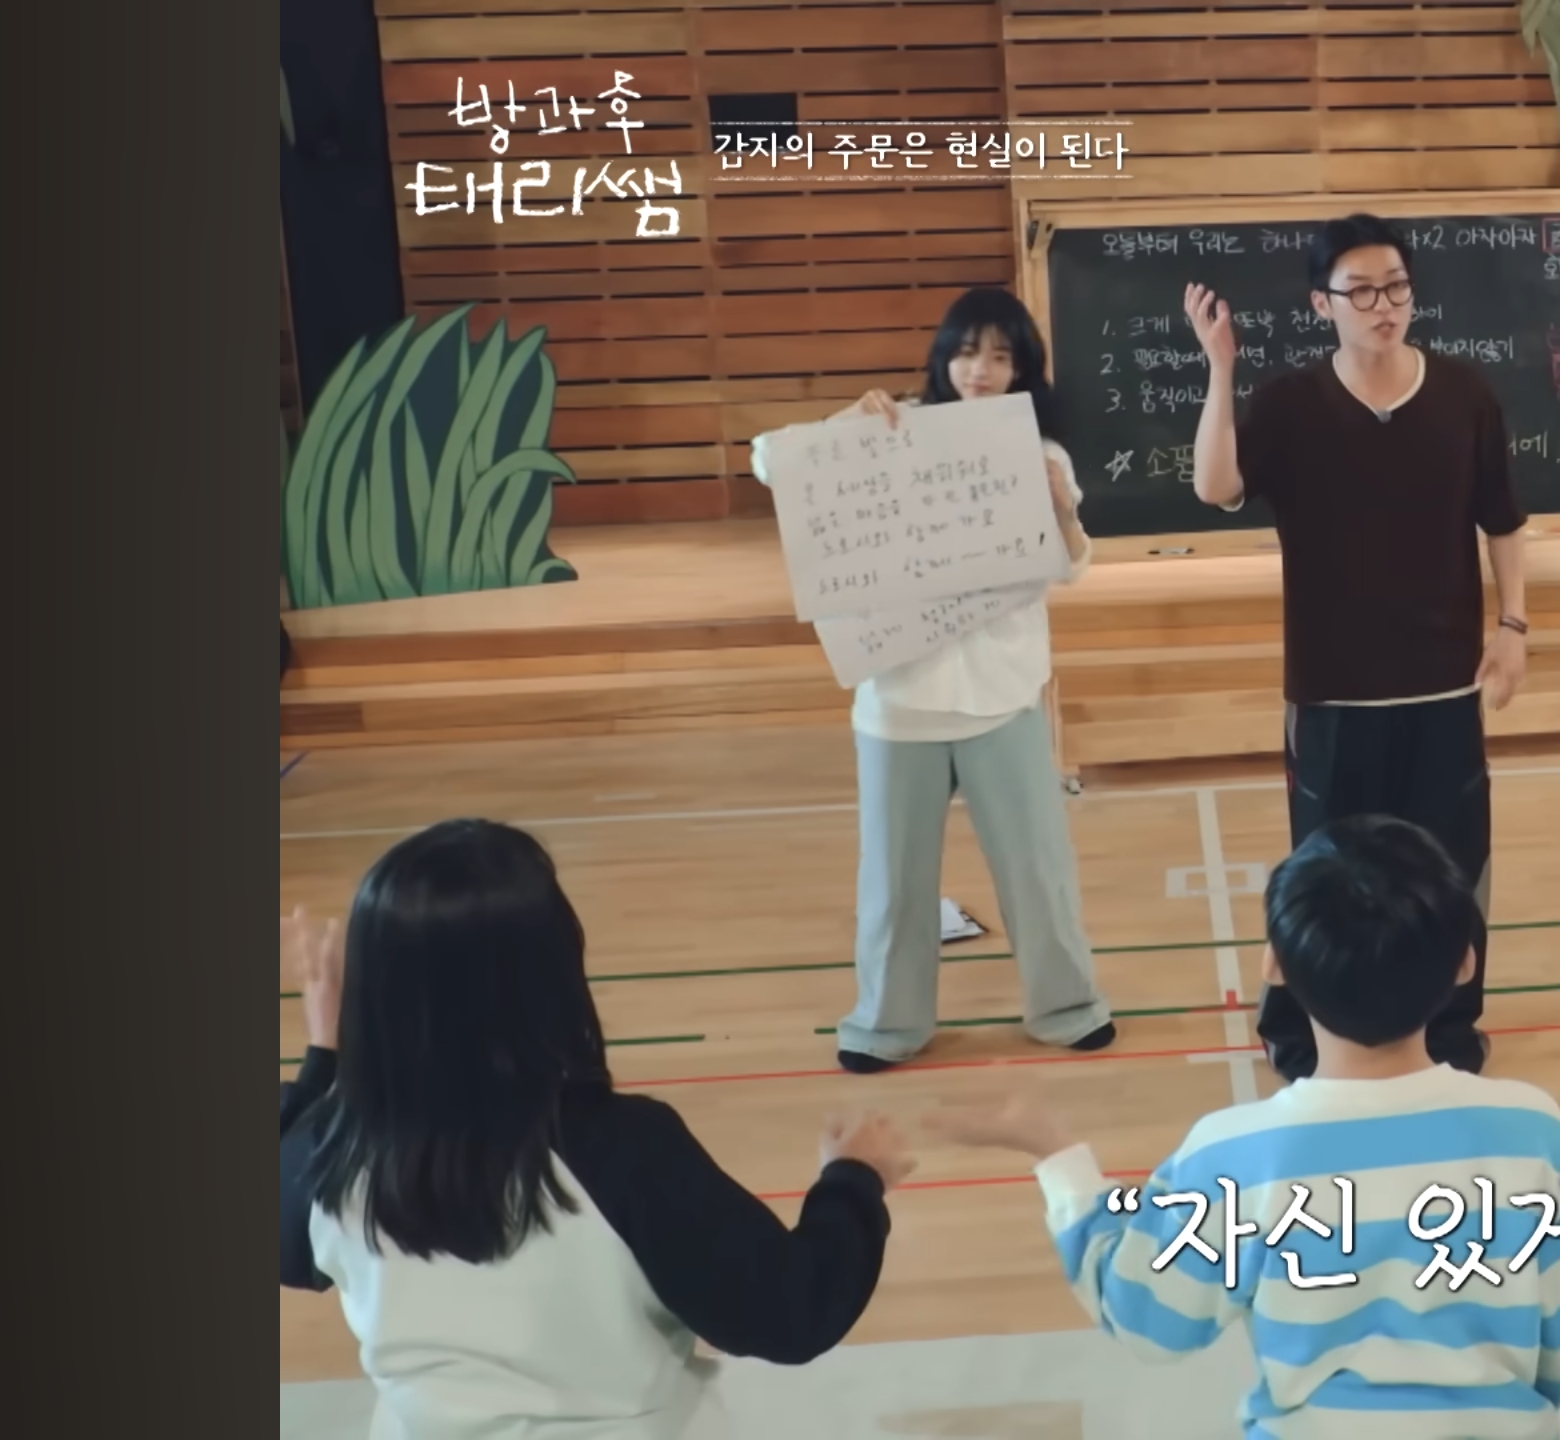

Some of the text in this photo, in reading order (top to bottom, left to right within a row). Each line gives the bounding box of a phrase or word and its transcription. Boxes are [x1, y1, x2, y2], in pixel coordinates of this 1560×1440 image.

[1103, 232, 1178, 260] 오늘부터
[1189, 229, 1244, 255] 우리는
[1456, 225, 1537, 250] 아자아자
[1102, 320, 1116, 335] 1.
[1128, 314, 1170, 338] 크게
[1100, 353, 1121, 375] 2.
[1105, 388, 1126, 413] 3.
